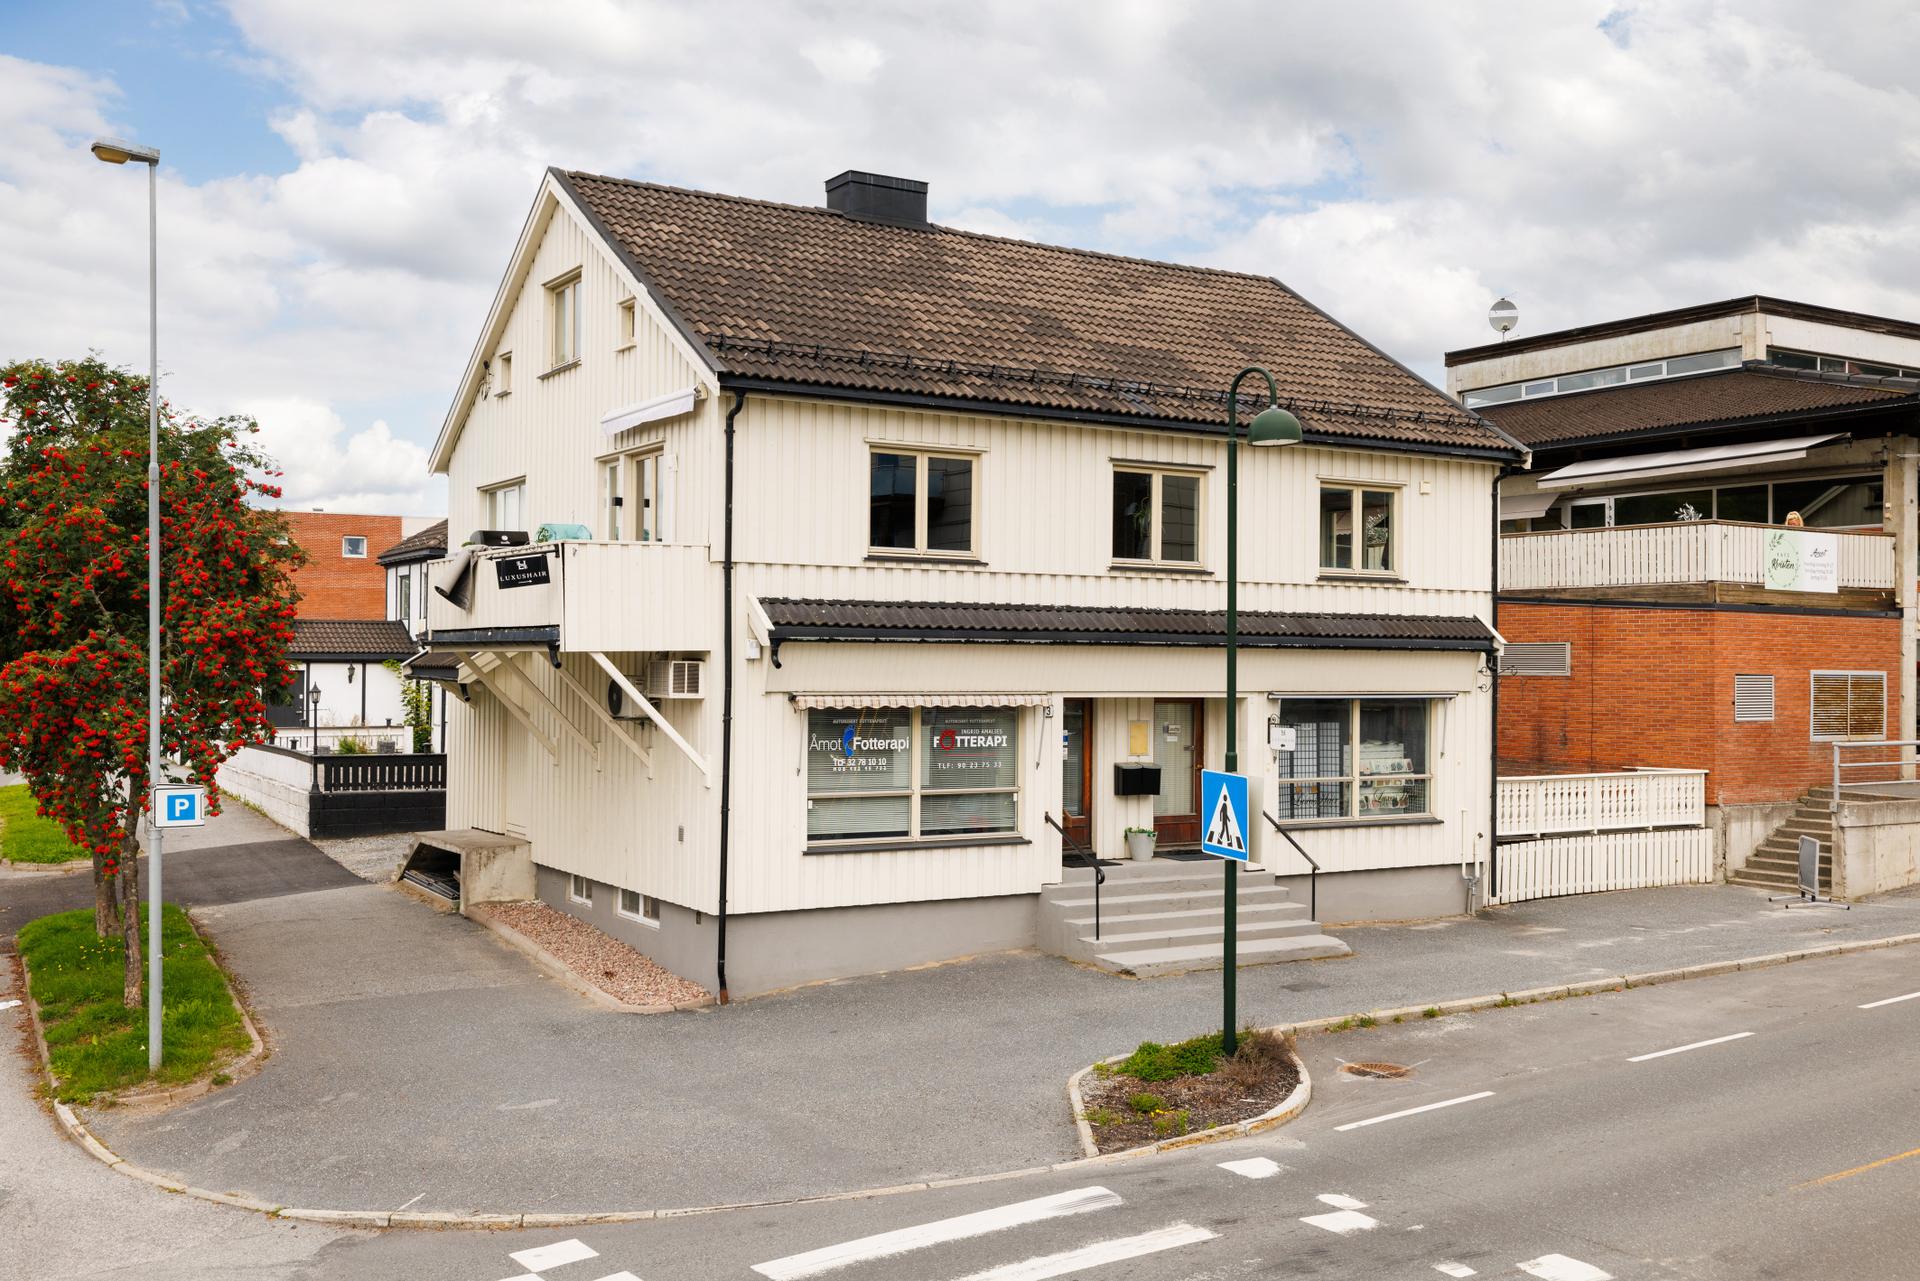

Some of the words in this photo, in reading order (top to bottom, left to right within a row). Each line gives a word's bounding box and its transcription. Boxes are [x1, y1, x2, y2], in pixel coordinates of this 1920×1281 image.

[499, 571, 547, 582] LUXUSHAIR
[1046, 706, 1051, 716] 3
[809, 733, 842, 751] Åmot
[853, 736, 910, 753] Fotterapi
[933, 730, 1008, 750] FOTTERAPI
[847, 758, 856, 767] 32
[858, 758, 867, 766] 78
[868, 757, 877, 766] 10
[878, 757, 887, 766] 10
[175, 798, 190, 817] P
